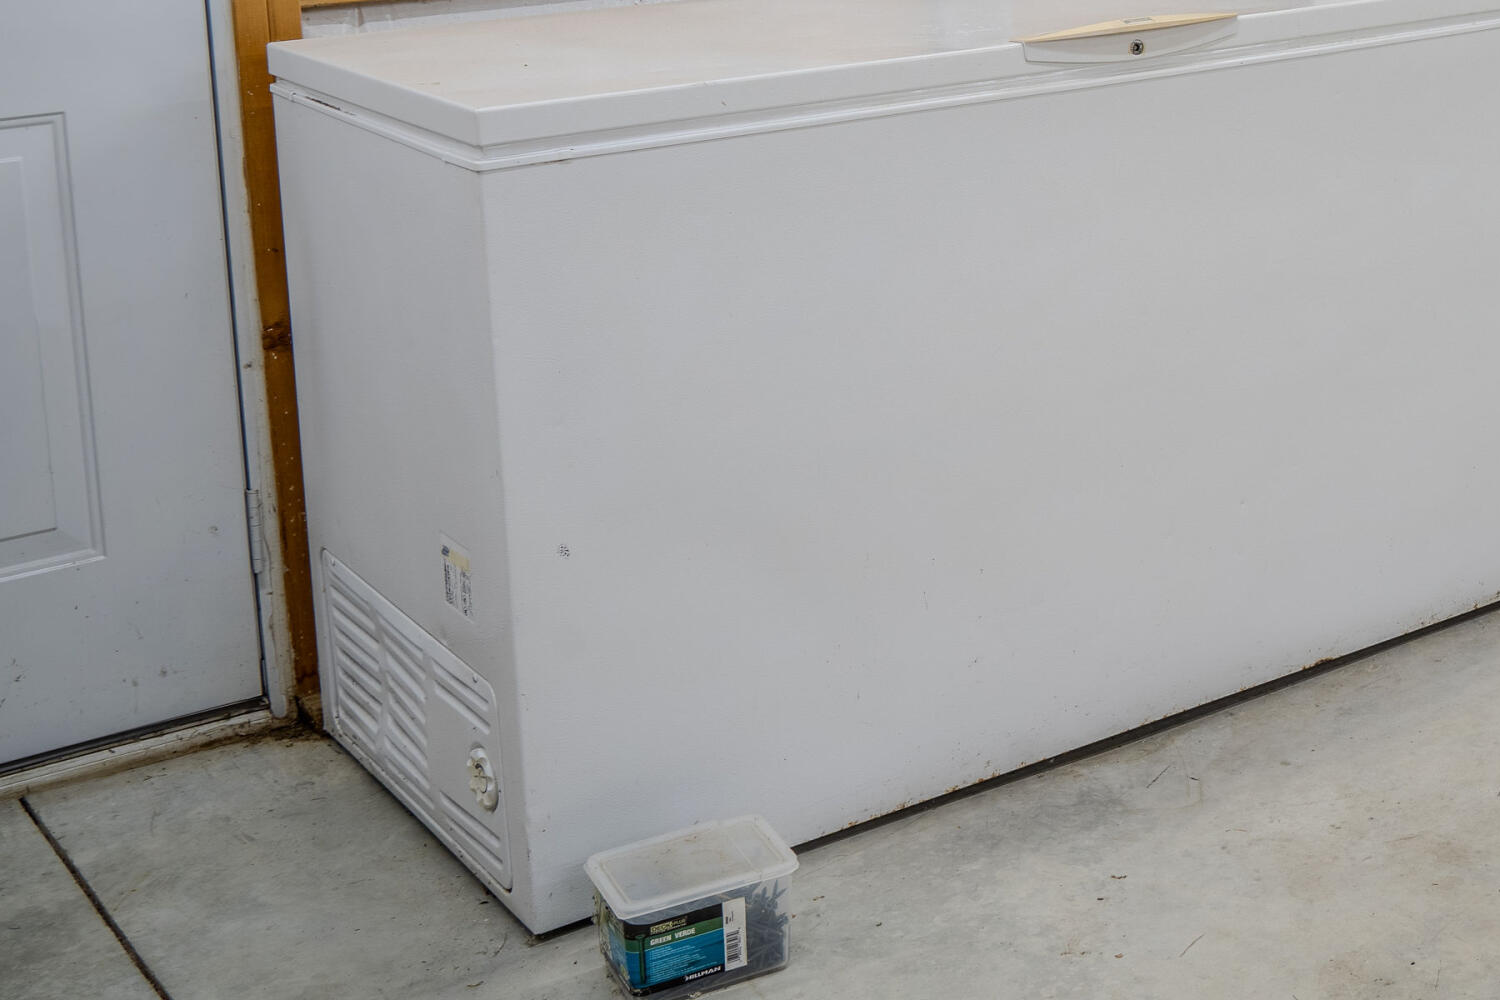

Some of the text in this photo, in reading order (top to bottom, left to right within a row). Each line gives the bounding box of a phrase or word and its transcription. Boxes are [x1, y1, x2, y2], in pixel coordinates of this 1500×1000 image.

[650, 928, 696, 946] GREEN VERDE
[685, 966, 721, 981] HILLMAN
